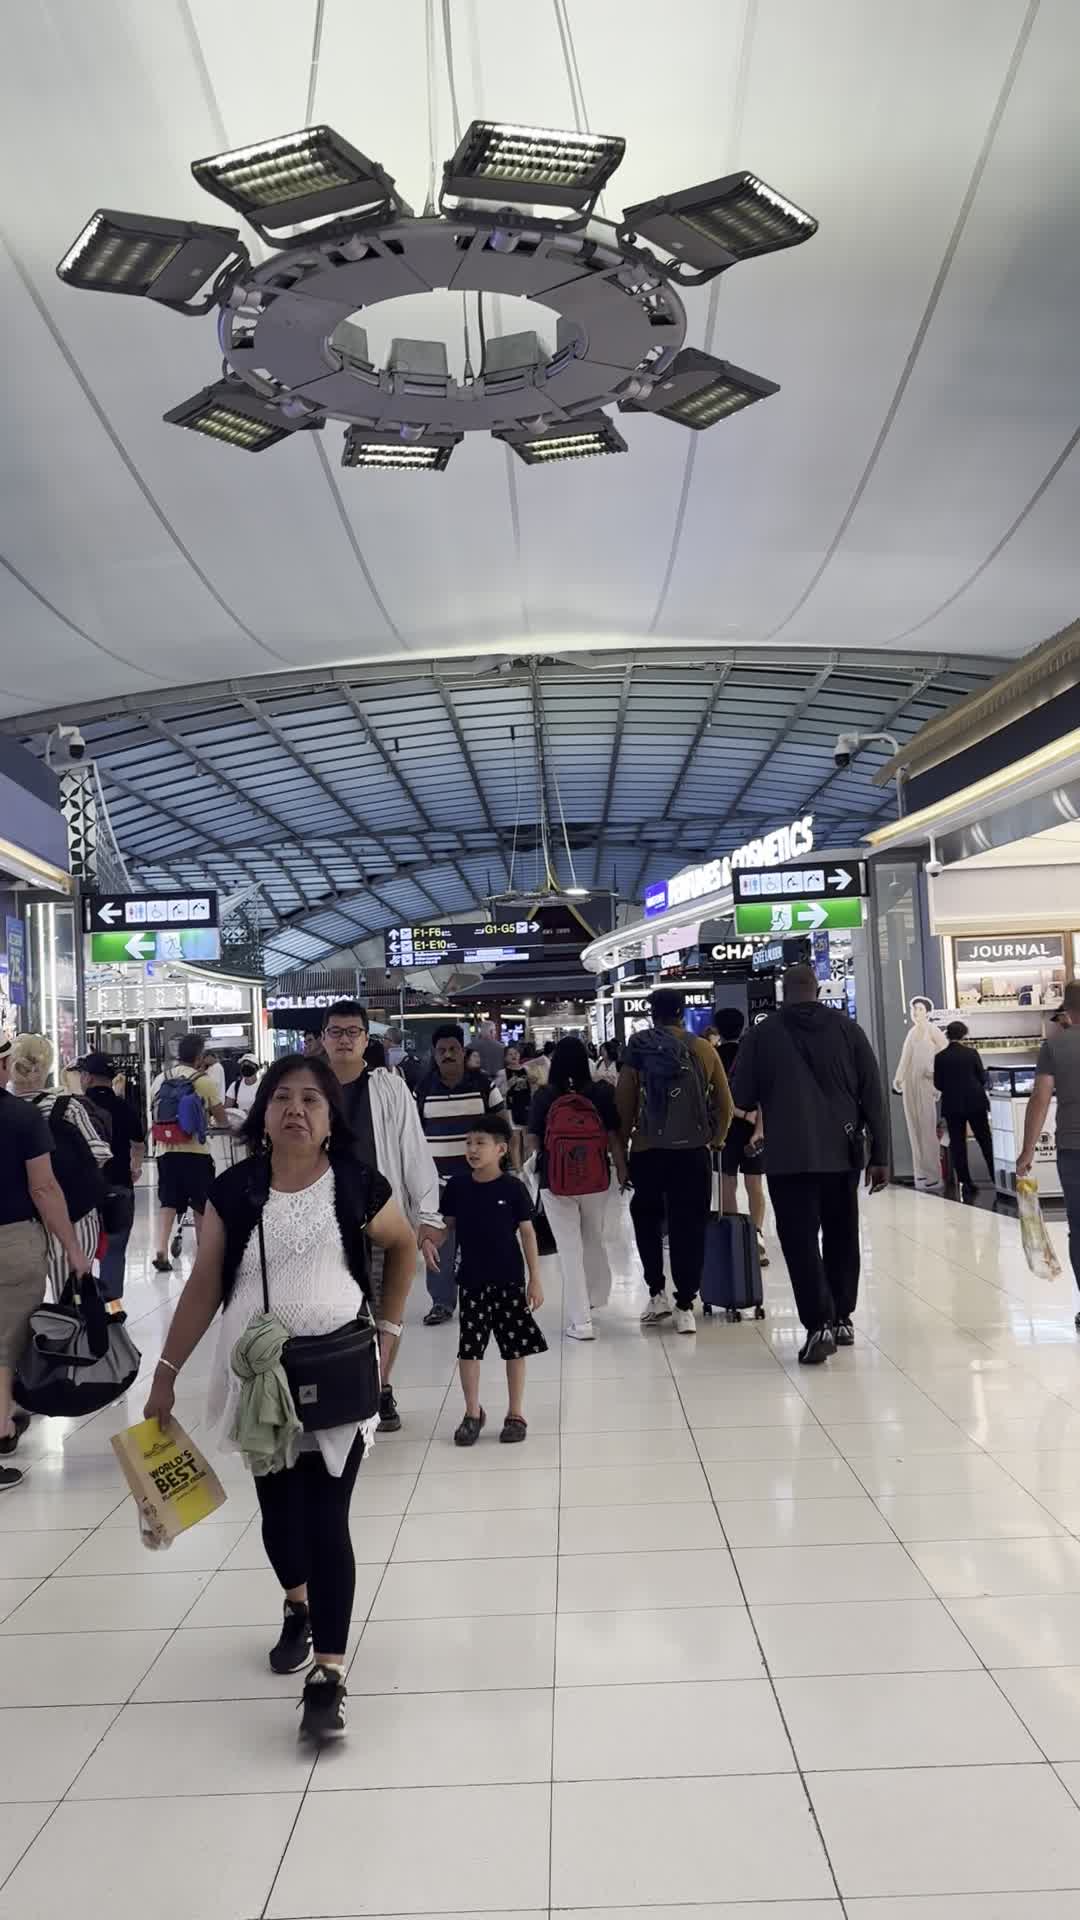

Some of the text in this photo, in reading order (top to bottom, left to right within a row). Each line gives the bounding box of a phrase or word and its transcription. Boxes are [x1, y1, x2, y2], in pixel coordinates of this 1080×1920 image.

[413, 928, 441, 937] F1-F6
[484, 923, 516, 934] G1-G5
[414, 940, 447, 950] E1-E10
[969, 943, 1050, 958] JOURNAL
[711, 944, 754, 960] CHA
[684, 994, 709, 1005] NEL
[149, 1449, 193, 1480] WORLD'S
[154, 1458, 199, 1495] BEST
